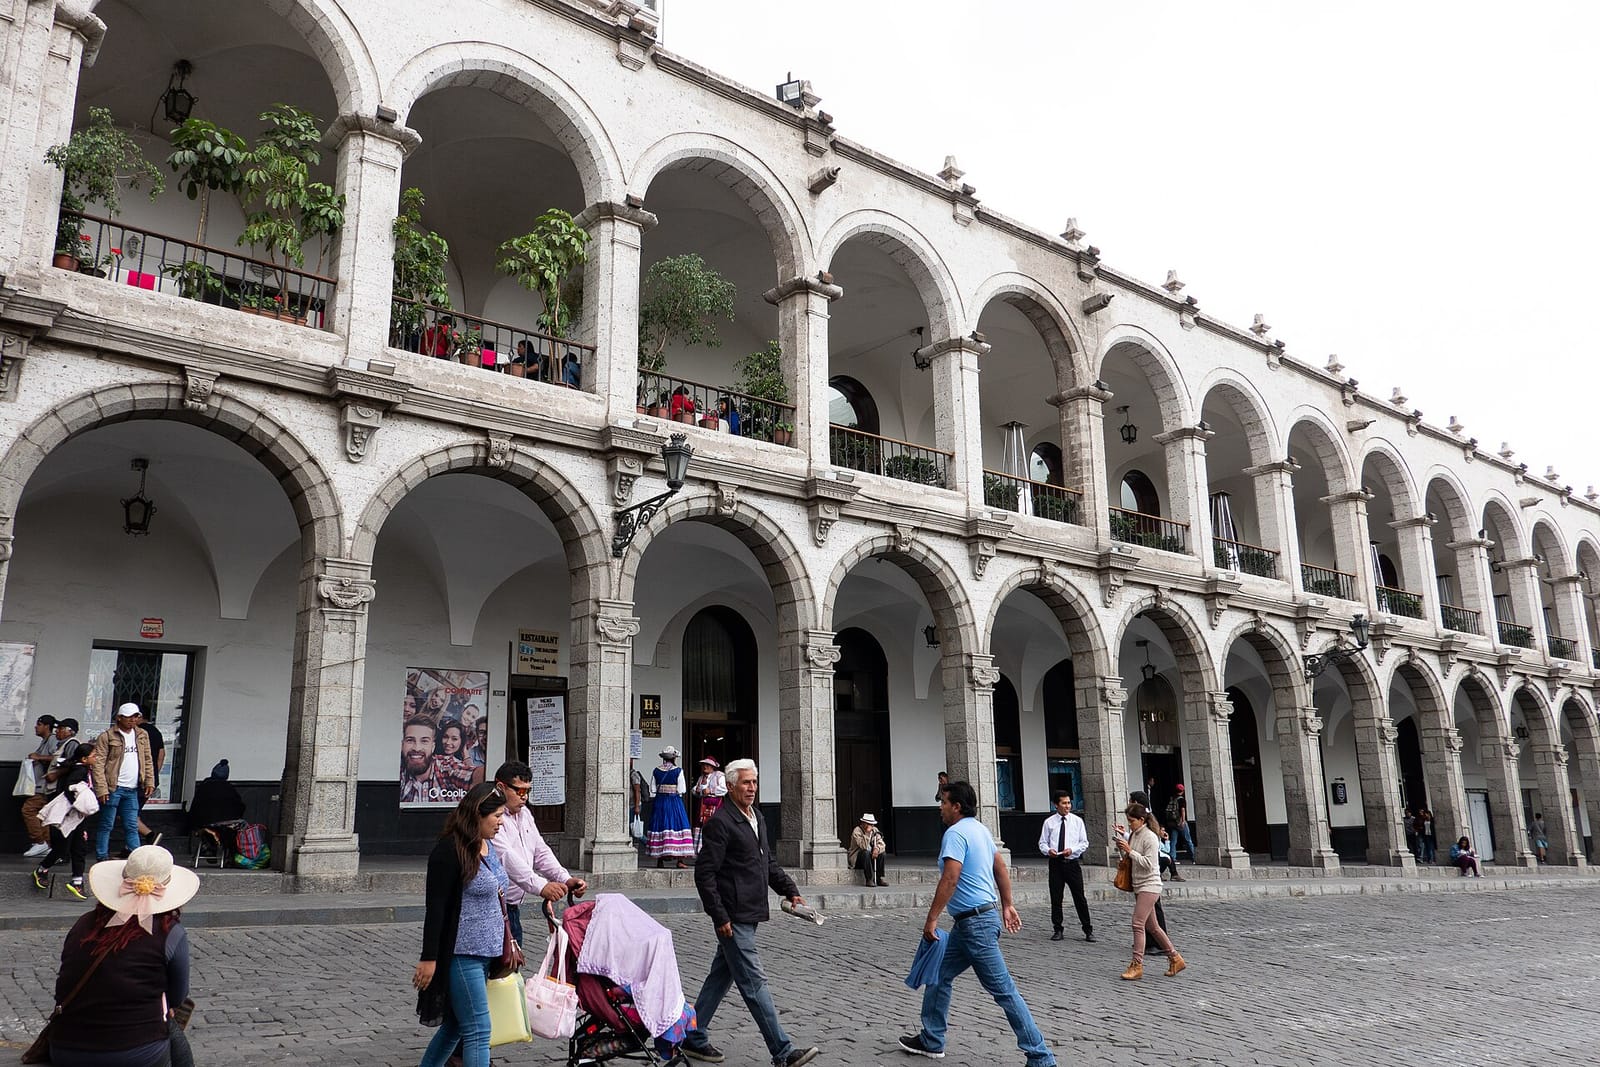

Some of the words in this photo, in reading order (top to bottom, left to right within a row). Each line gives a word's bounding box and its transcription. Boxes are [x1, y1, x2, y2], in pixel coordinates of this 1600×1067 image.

[521, 634, 559, 645] RESTAURANT
[445, 687, 482, 696] COMPARTE
[440, 788, 468, 799] Coolb
